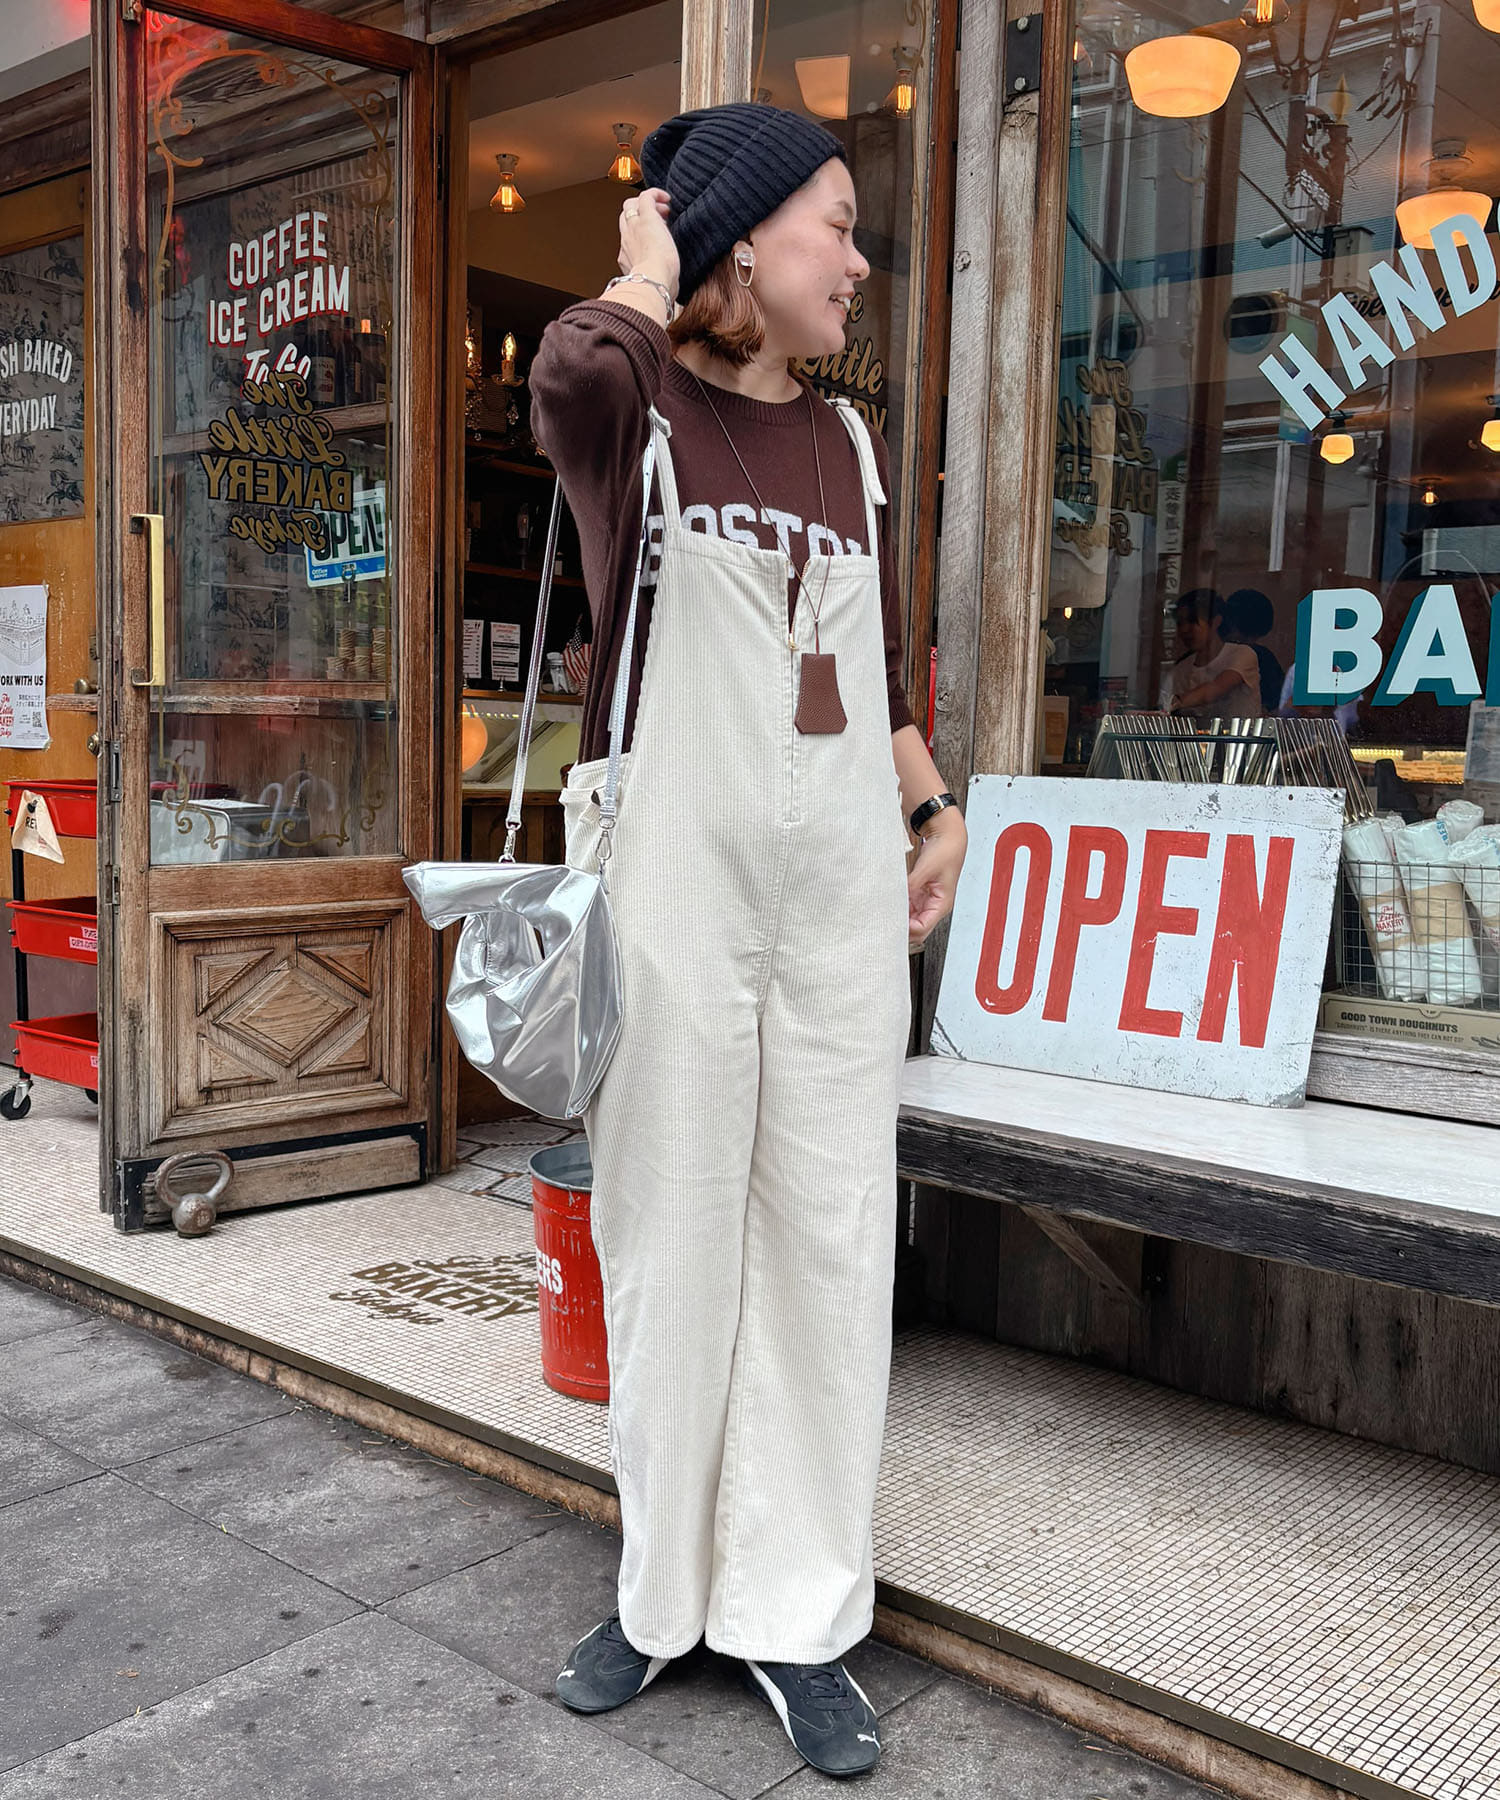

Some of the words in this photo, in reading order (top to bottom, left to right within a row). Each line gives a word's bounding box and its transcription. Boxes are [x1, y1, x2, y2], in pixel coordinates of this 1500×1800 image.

[228, 211, 328, 289] COFFEE
[208, 297, 247, 346] ICE
[258, 265, 349, 337] CREAM
[1258, 201, 1500, 431] HAND
[23, 339, 72, 383] BAKED
[314, 503, 384, 561] OPEN
[1293, 584, 1500, 706] BA
[0, 675, 13, 686] ORK
[15, 675, 33, 686] WITH
[34, 675, 44, 686] US
[974, 821, 1295, 1049] OPEN
[1340, 1011, 1367, 1023] GOOD
[1368, 1014, 1398, 1027] TOWN
[1399, 1018, 1458, 1033] DOUGHNUTS
[350, 1262, 538, 1321] BAKERY
